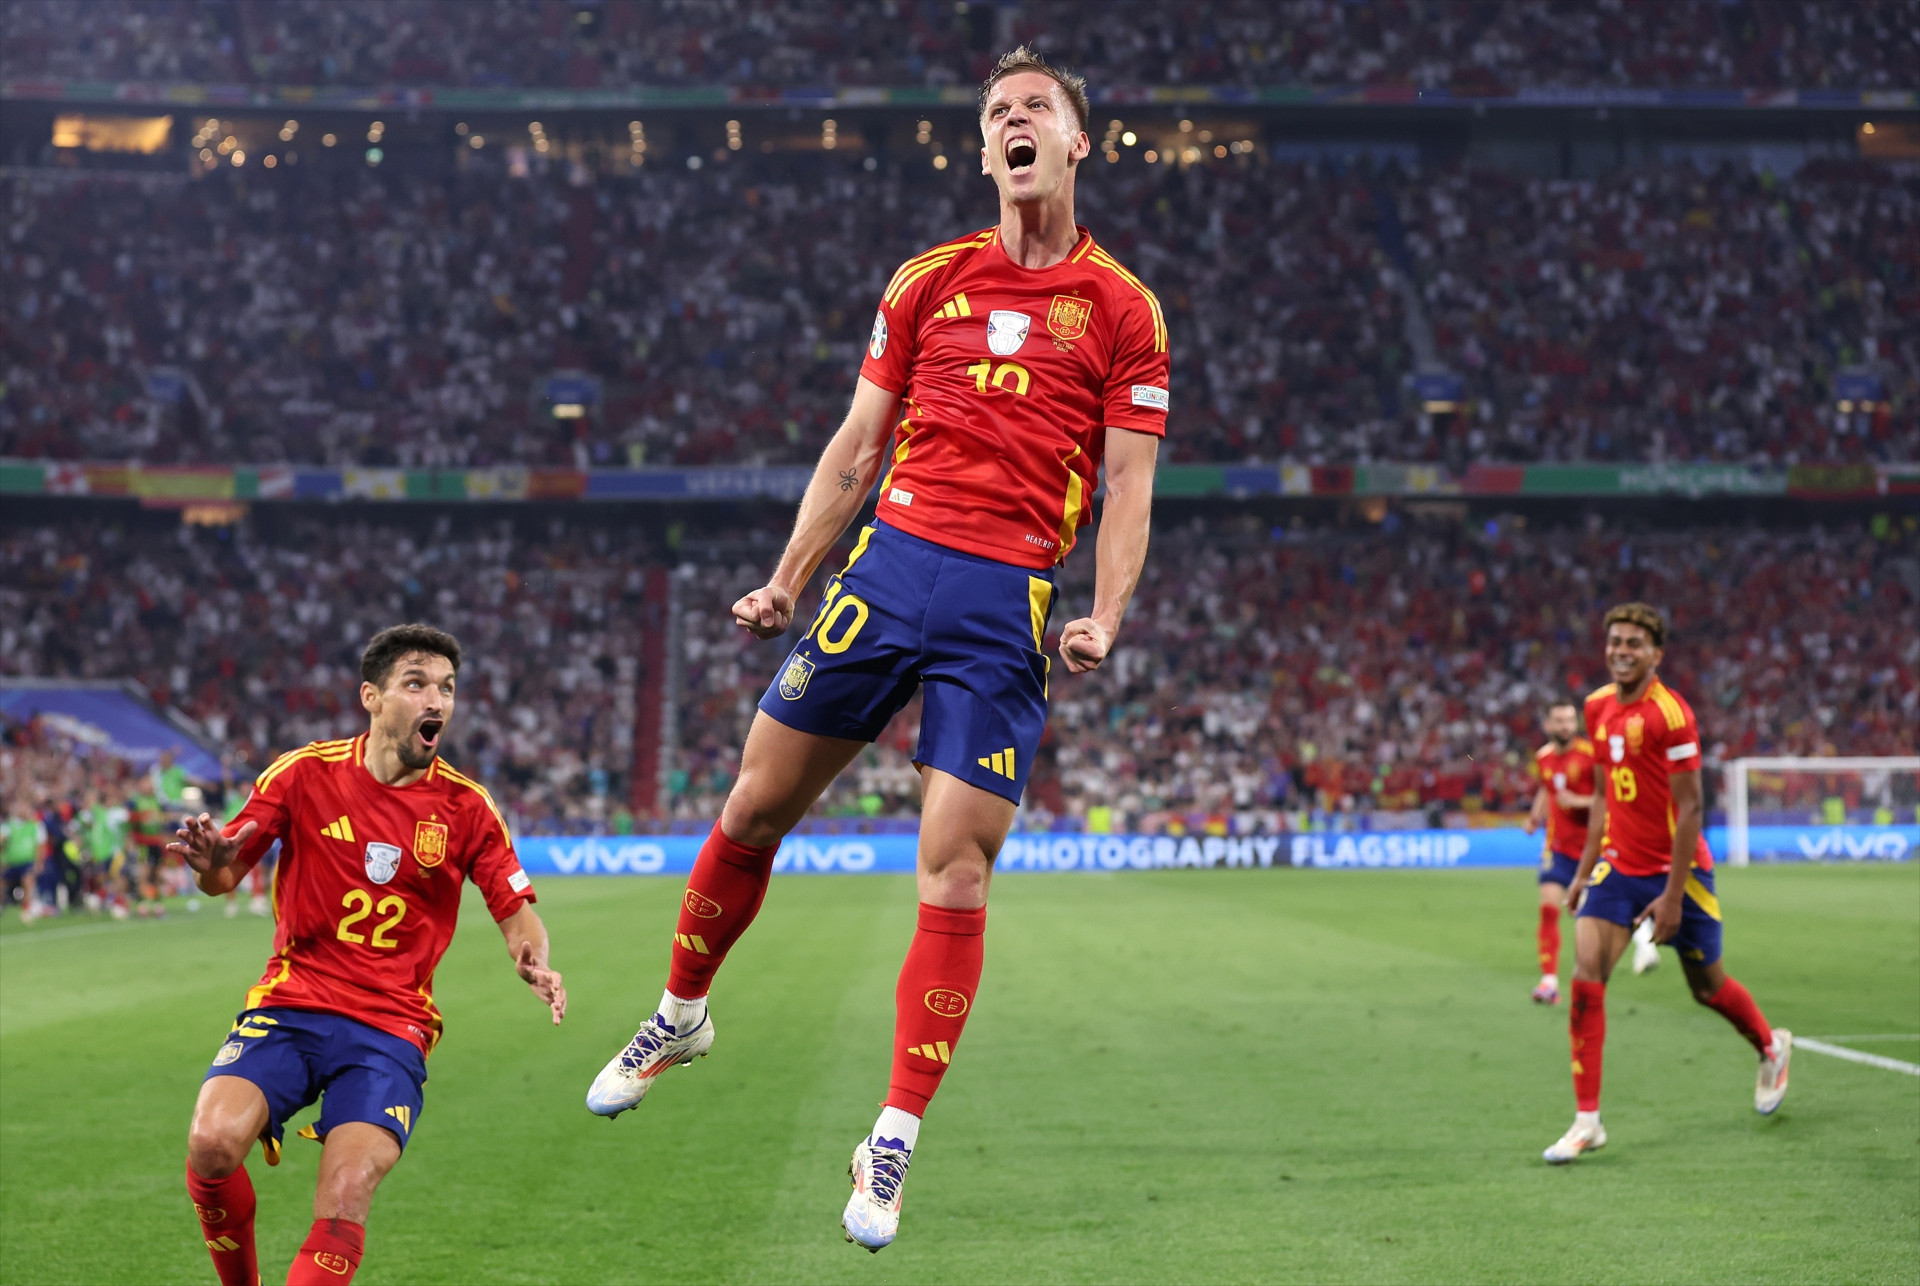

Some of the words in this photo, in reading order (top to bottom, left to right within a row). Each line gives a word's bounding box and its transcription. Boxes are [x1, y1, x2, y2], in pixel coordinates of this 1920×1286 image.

[1025, 533, 1055, 549] HEAT.RDY
[805, 580, 869, 654] 10
[1610, 766, 1638, 802] 19
[548, 838, 665, 873] vivo
[1000, 836, 1280, 870] PHOTOGRAPHY
[1290, 834, 1471, 868] FLAGSHIP
[1797, 827, 1909, 860] vivo
[336, 888, 407, 948] 22
